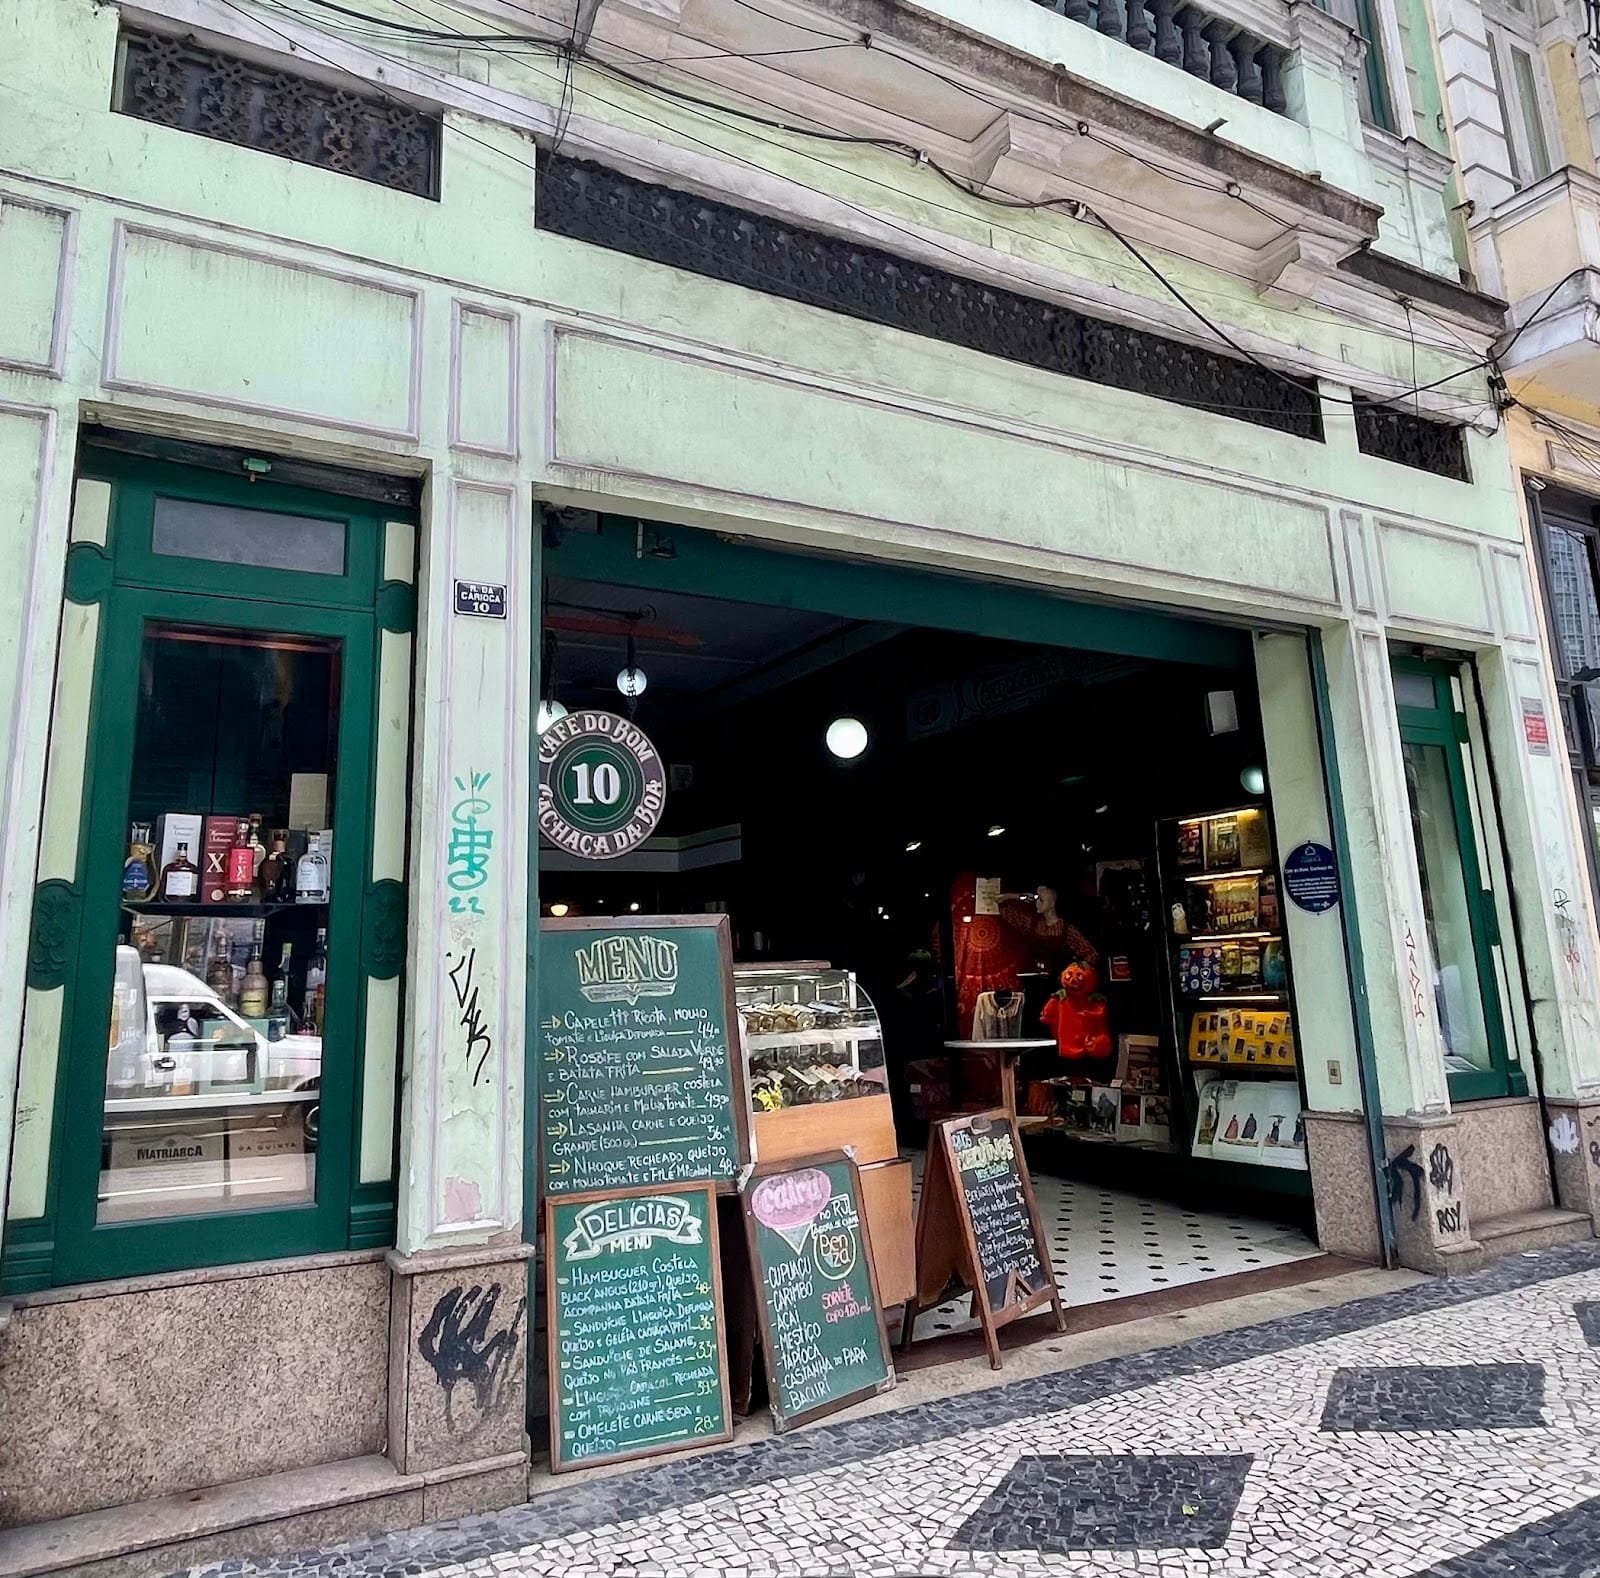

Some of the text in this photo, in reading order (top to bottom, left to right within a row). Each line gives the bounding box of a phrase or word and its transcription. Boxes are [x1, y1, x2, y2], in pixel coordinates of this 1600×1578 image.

[461, 592, 501, 603] CARIOCA
[482, 586, 494, 594] DA
[473, 602, 490, 613] 10
[584, 714, 611, 732] DO
[610, 719, 654, 763] BOM
[572, 763, 621, 805] 10
[613, 823, 642, 850] DA
[634, 779, 662, 828] BOA
[206, 853, 225, 873] X
[575, 935, 678, 985] MENU
[650, 1045, 693, 1059] SALADA
[566, 1082, 606, 1104] CARNE
[548, 1107, 569, 1118] COM
[569, 1118, 629, 1136] LASANHA
[632, 1118, 665, 1131] CARNE
[677, 1113, 714, 1127] QUEIJO
[137, 1144, 204, 1161] MATRIARCA
[257, 1142, 297, 1152] QUINTA
[552, 1140, 598, 1157] GRANDE
[627, 1151, 683, 1169] RECHEADO
[687, 1144, 727, 1163] QUEIJO
[549, 1180, 569, 1191] COM
[610, 1236, 652, 1254] MENU
[561, 1287, 592, 1305] BLACK
[594, 1285, 628, 1299] ANGUS
[637, 1345, 651, 1357] DE
[569, 1409, 591, 1421] COM
[578, 1413, 631, 1439] OMELETE
[572, 1436, 617, 1457] QUEIJO
